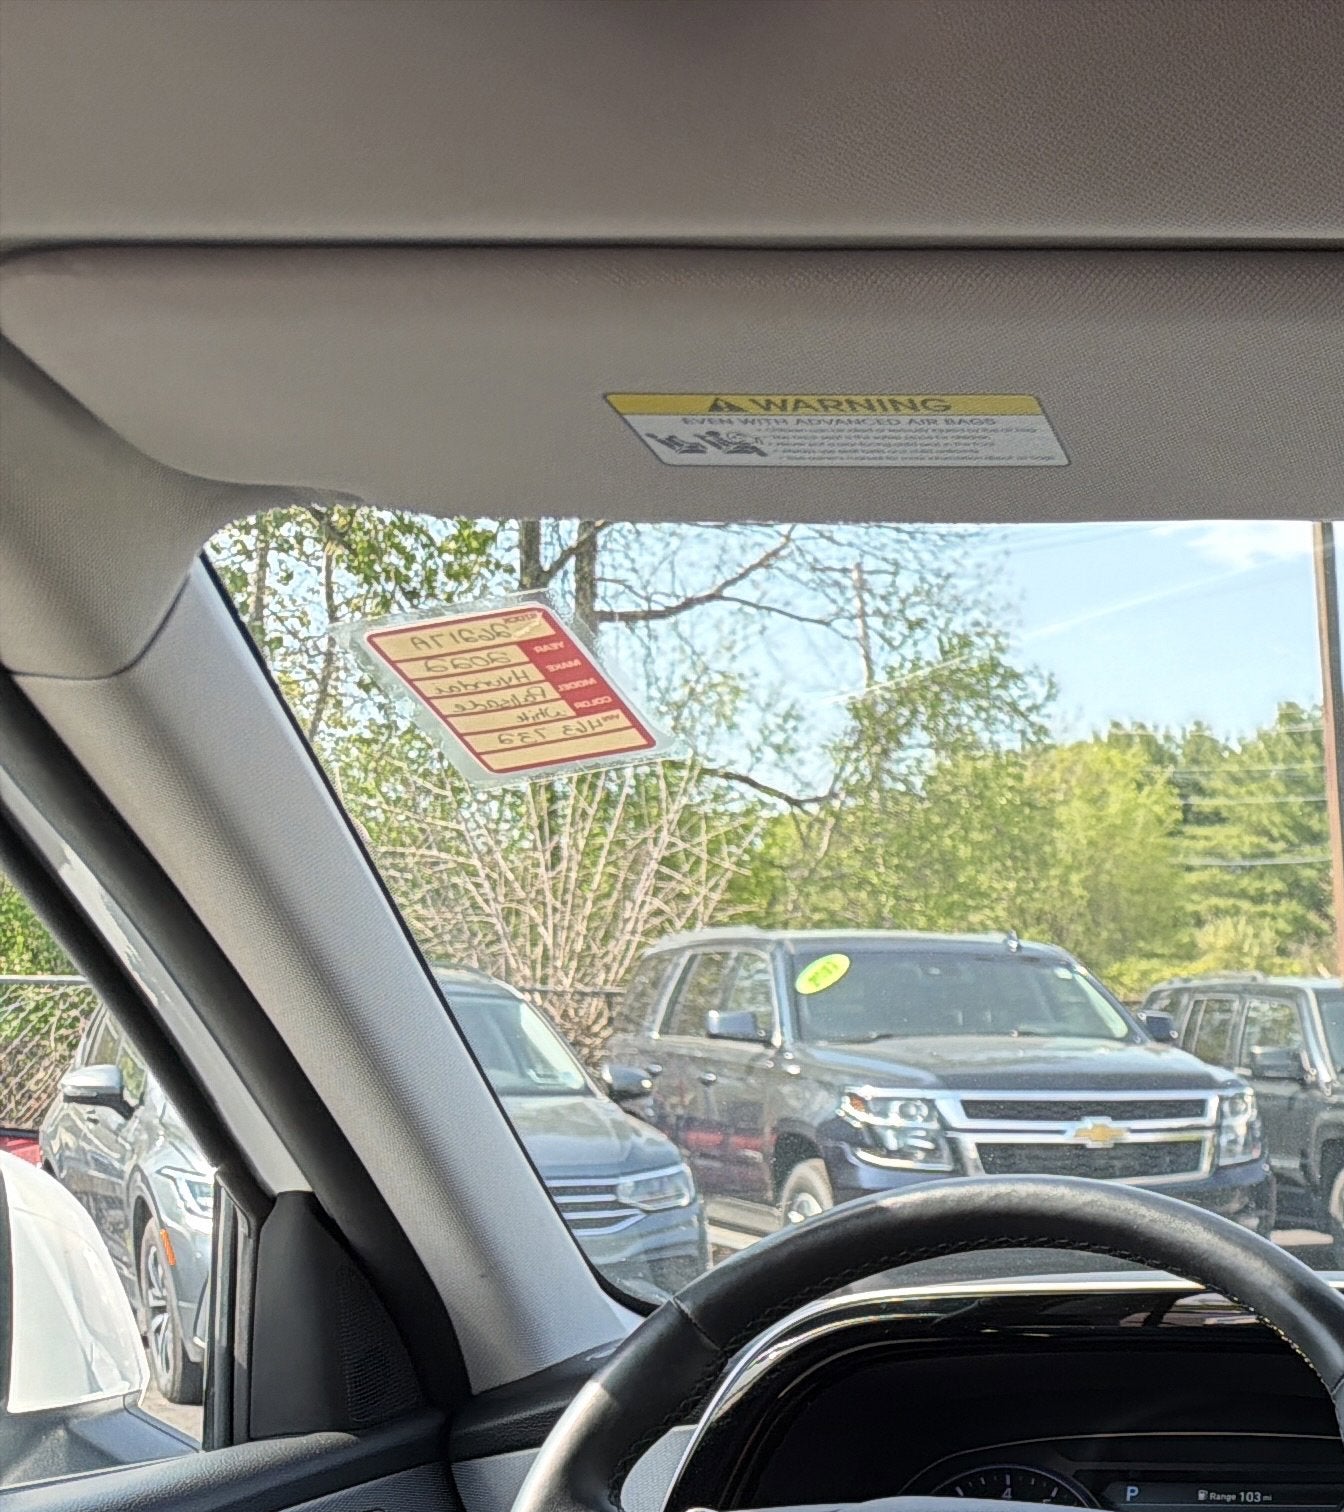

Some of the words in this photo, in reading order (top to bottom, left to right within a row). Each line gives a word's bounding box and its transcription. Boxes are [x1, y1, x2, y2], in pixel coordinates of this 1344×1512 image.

[750, 398, 952, 413] WARNING
[682, 417, 734, 425] EVEN
[737, 417, 789, 426] WITH
[795, 417, 900, 426] ADVANCED
[908, 417, 938, 426] AIR
[944, 417, 996, 426] BAGS
[1126, 1486, 1139, 1502] P
[1209, 1491, 1237, 1503] Range
[1238, 1490, 1261, 1503] 103
